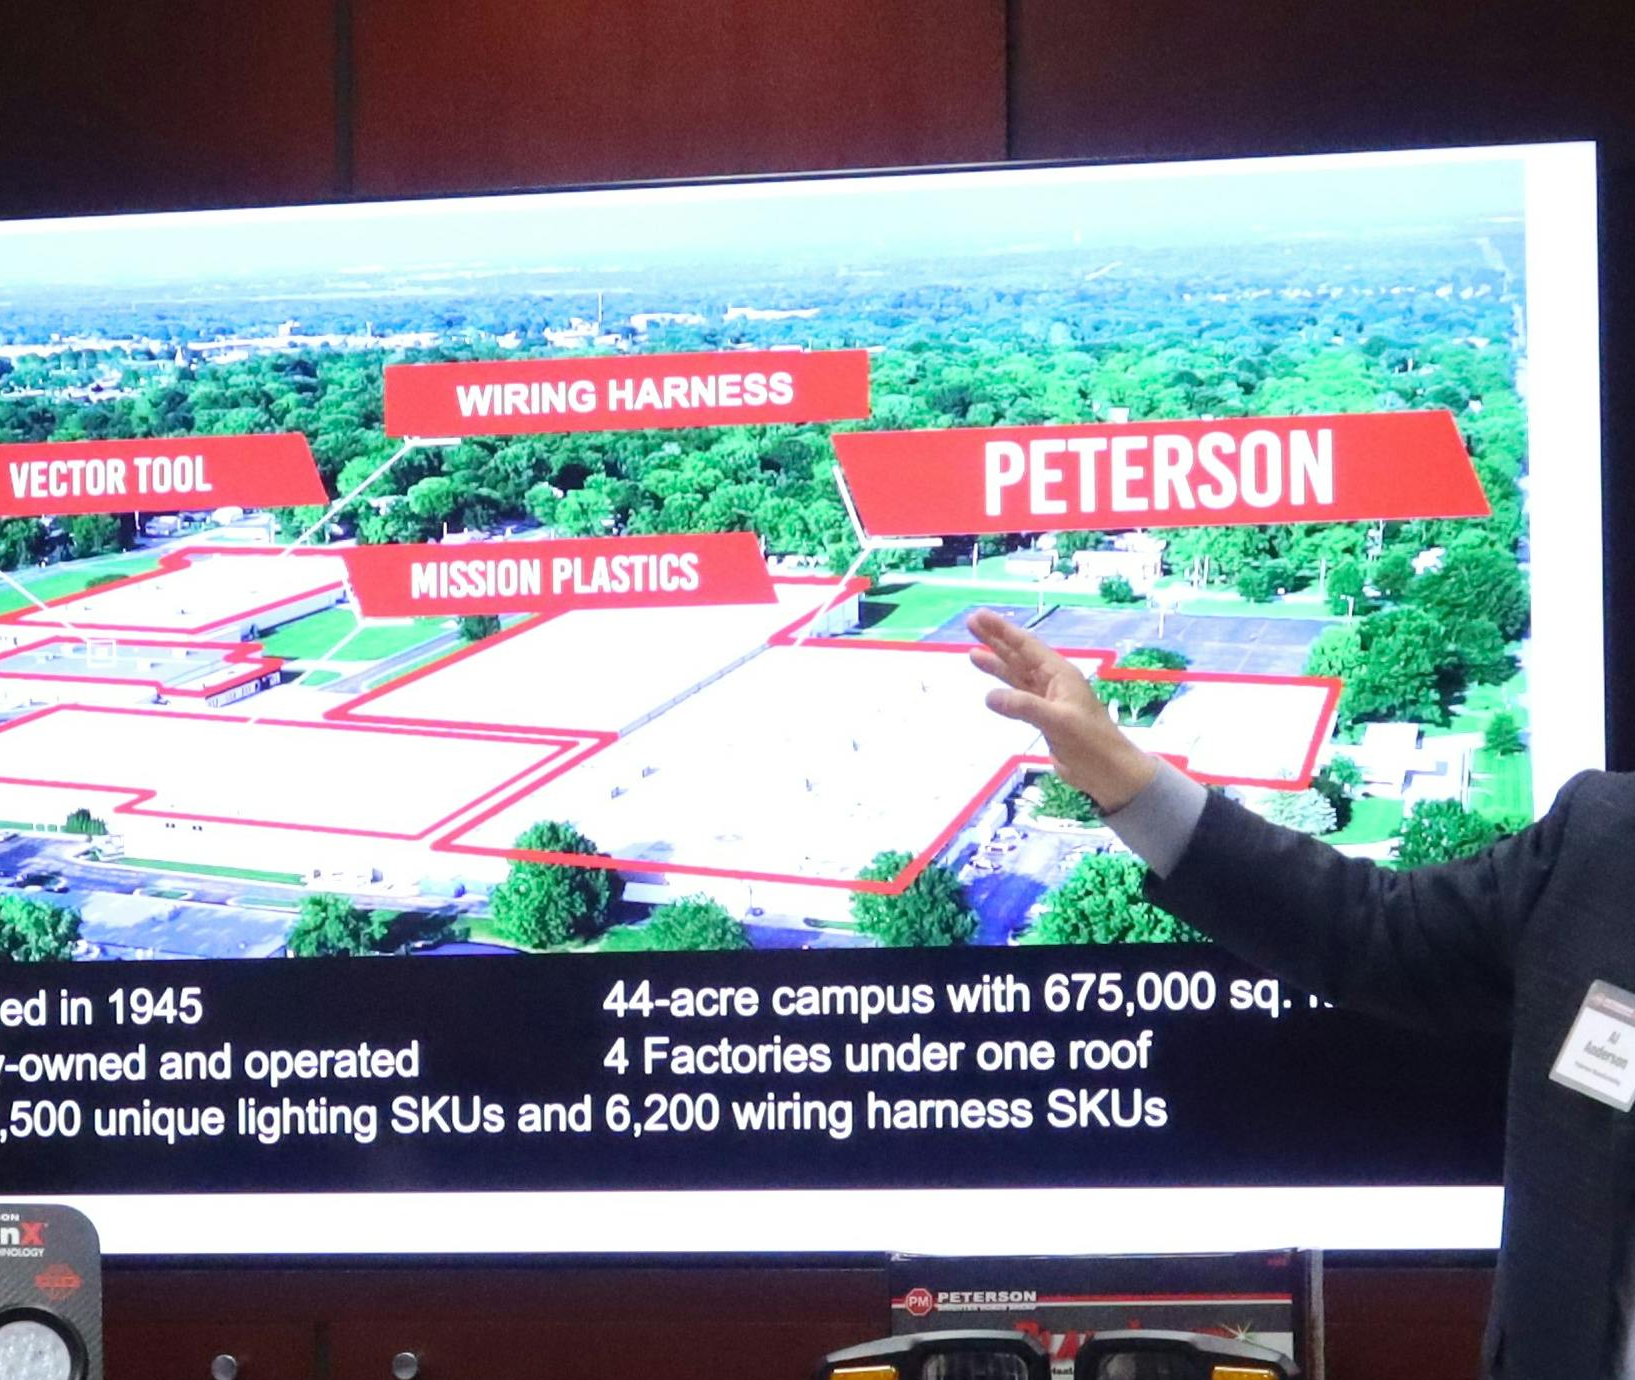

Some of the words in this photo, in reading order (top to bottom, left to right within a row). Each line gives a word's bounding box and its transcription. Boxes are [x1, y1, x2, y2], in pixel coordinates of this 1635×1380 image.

[455, 379, 597, 417] WIRING
[608, 371, 795, 411] HARNESS
[9, 458, 127, 499] VECTOR
[133, 455, 213, 495] TOOL
[984, 428, 1334, 516] PETERSON
[411, 558, 541, 599] MISSION
[552, 552, 700, 595] PLASTICS
[60, 989, 93, 1025] in
[108, 986, 203, 1025] 1945
[602, 978, 760, 1018] 44-acre
[771, 983, 935, 1024] campus
[946, 973, 1031, 1013] with
[1044, 970, 1217, 1018] 675,000
[1229, 978, 1292, 1018] sq.
[159, 1042, 232, 1081] and
[244, 1039, 420, 1088] operated
[603, 1037, 630, 1075] 4
[643, 1034, 833, 1075] Factories
[845, 1033, 966, 1073] under
[976, 1041, 1056, 1072] one
[1069, 1029, 1154, 1070] roof
[94, 1098, 226, 1145] unique
[238, 1096, 378, 1145] lighting
[390, 1095, 506, 1134] SKUs
[517, 1093, 592, 1133] and
[605, 1092, 720, 1138] 6,200
[731, 1091, 853, 1139] wiring
[867, 1090, 1034, 1130] harness
[1046, 1088, 1169, 1129] SKUs
[908, 1295, 929, 1308] PM
[937, 1290, 1037, 1304] PETERSON
